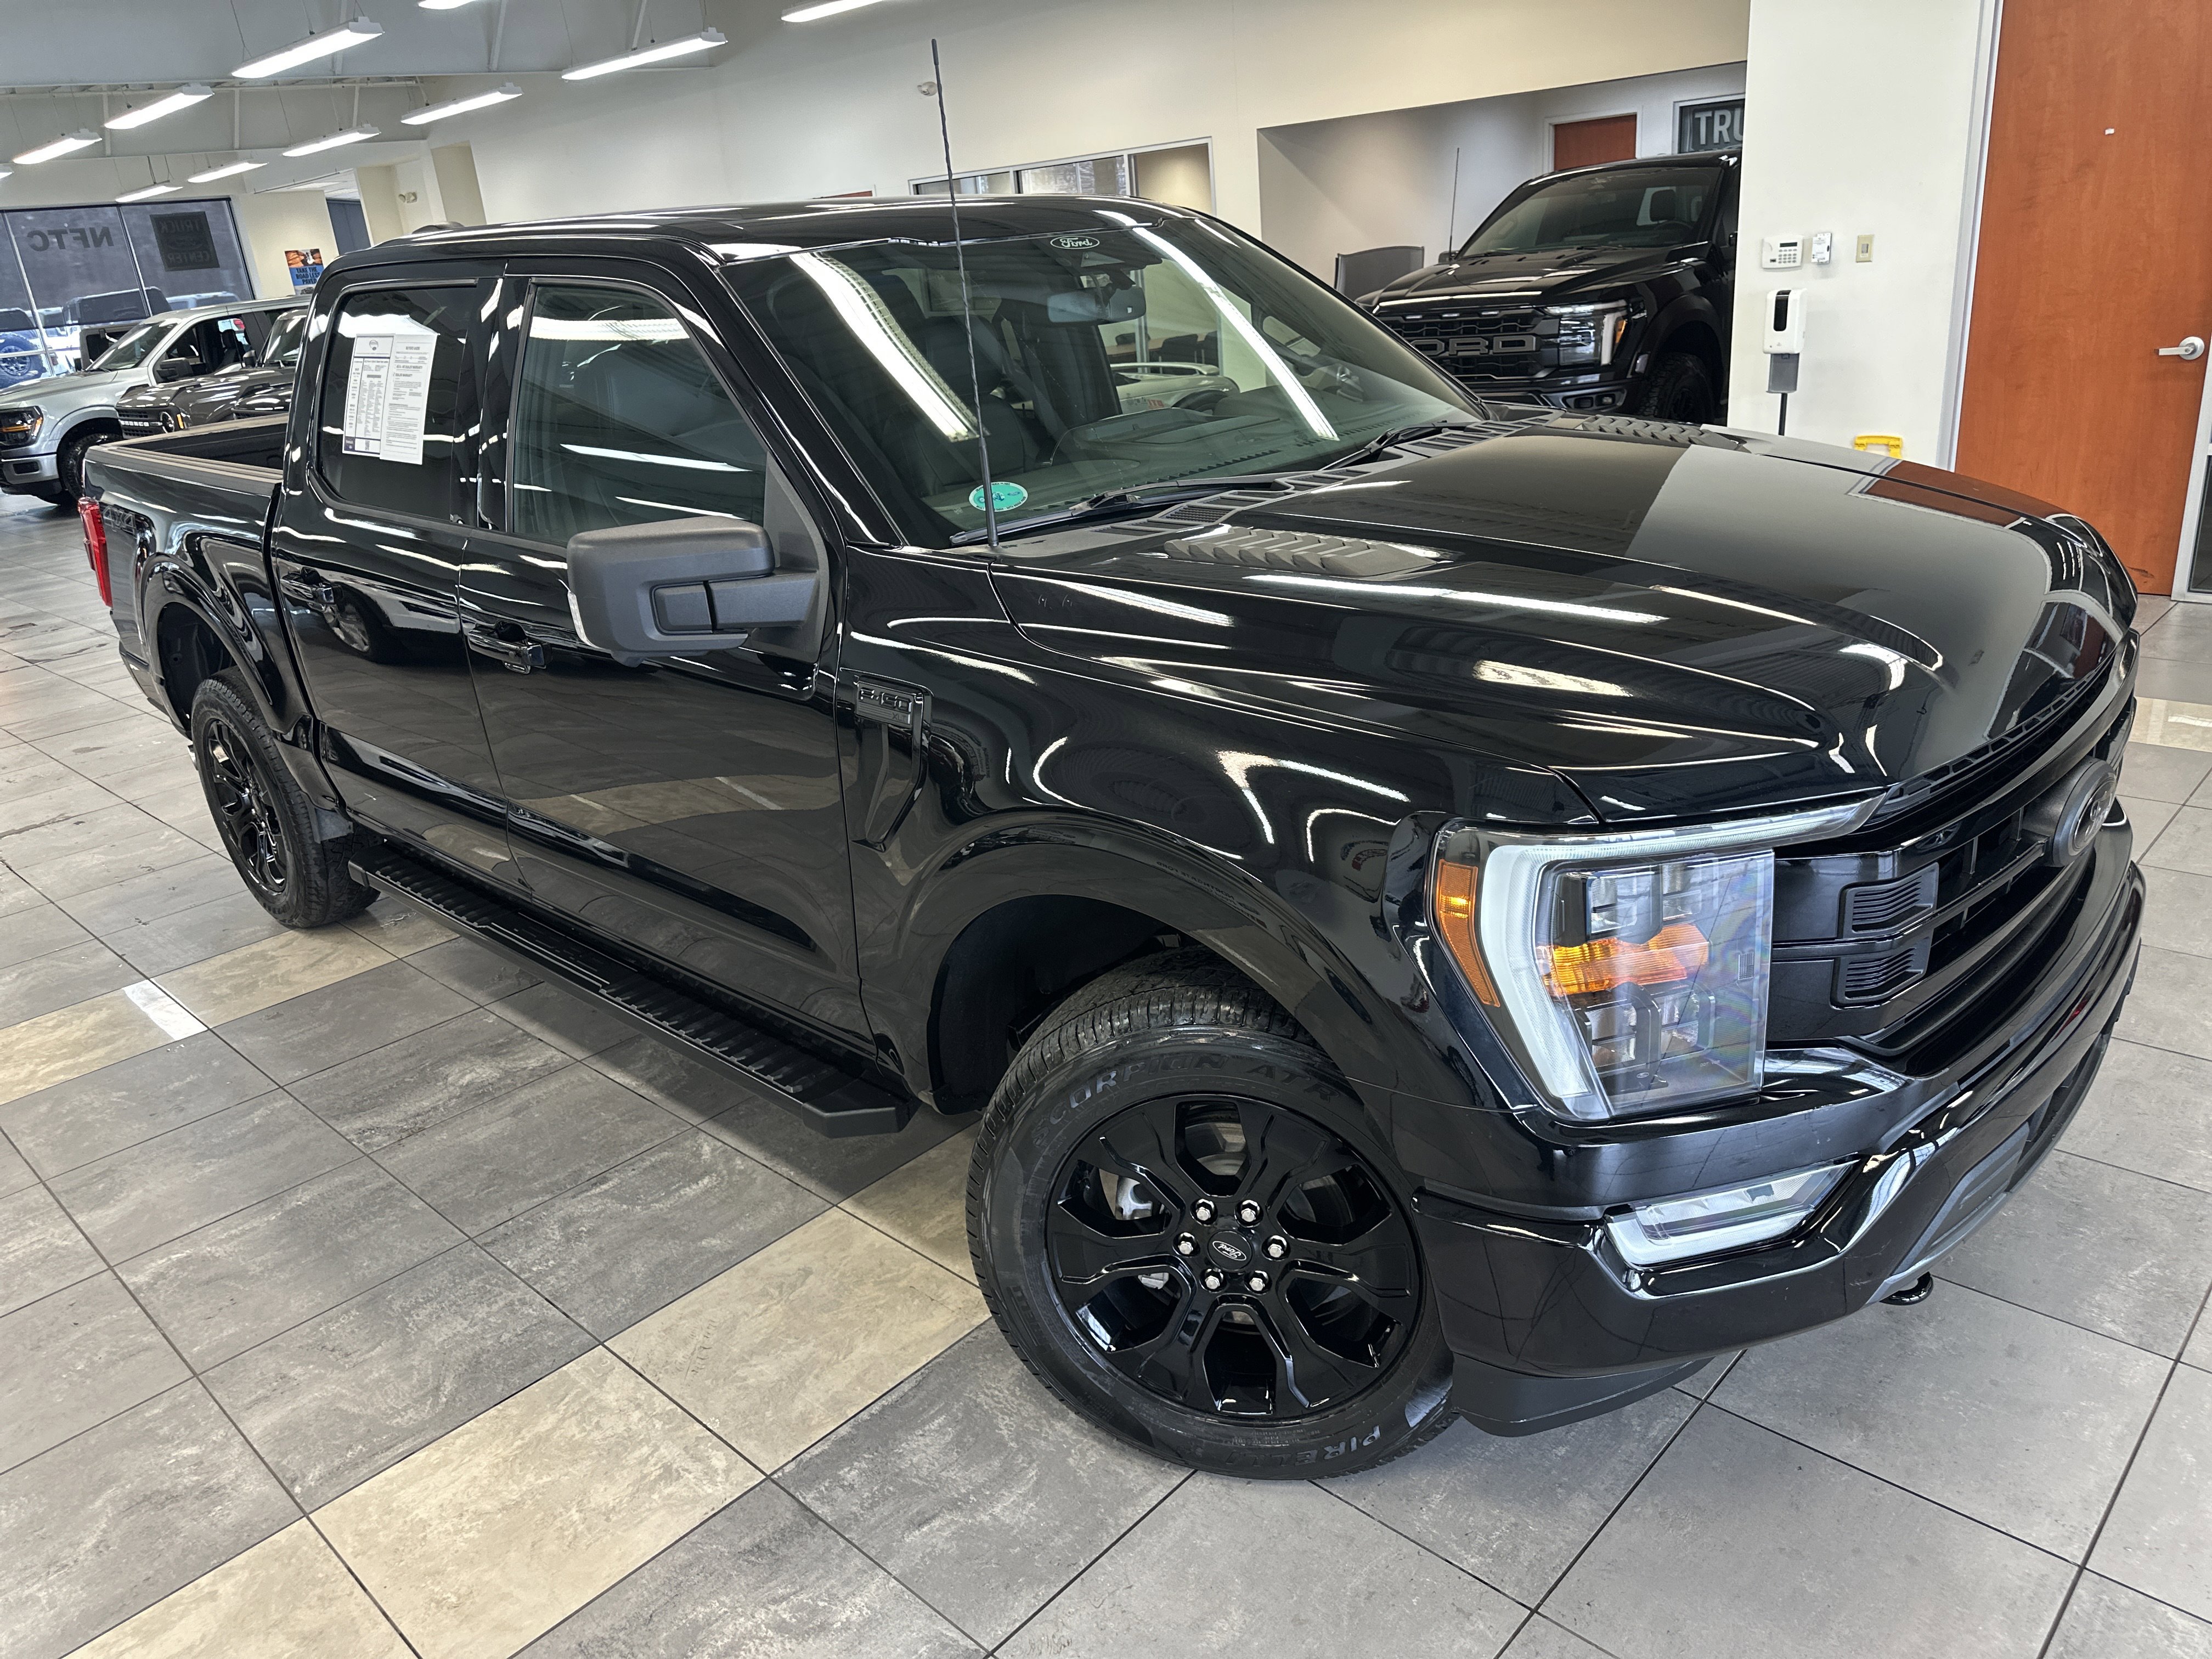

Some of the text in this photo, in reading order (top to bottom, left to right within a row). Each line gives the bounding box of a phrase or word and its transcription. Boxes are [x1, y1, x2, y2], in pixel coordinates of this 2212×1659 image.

[1694, 107, 1745, 145] TRU
[1059, 237, 1093, 248] Ford
[1410, 335, 1537, 357] ORD
[891, 712, 908, 723] XLT
[1031, 1053, 1230, 1148] SCORPION
[1245, 1064, 1340, 1103] ATR
[1217, 1243, 1242, 1259] Ford
[1224, 1425, 1381, 1467] PIRELLI
